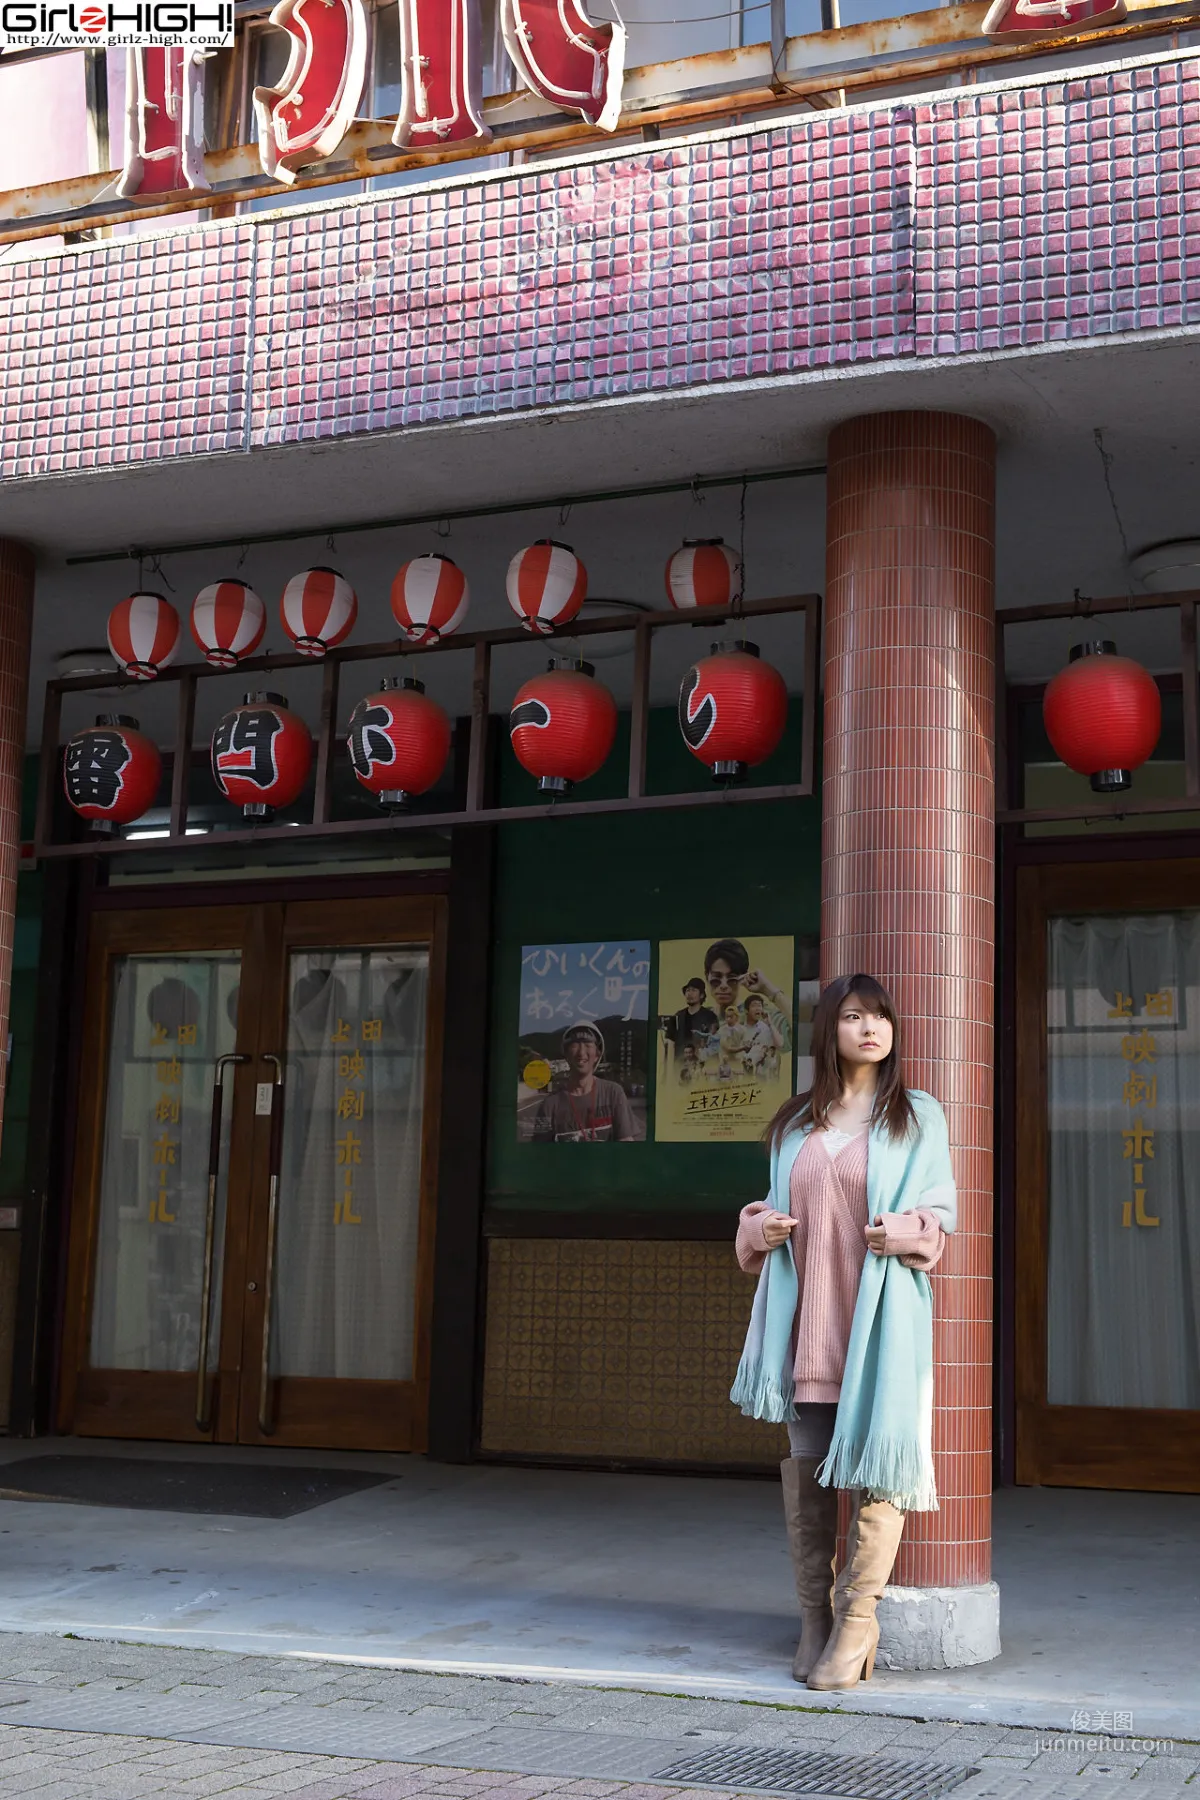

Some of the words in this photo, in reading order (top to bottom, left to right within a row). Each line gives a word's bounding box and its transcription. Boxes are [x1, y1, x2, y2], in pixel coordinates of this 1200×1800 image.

[686, 1088, 762, 1111] エキストランド
